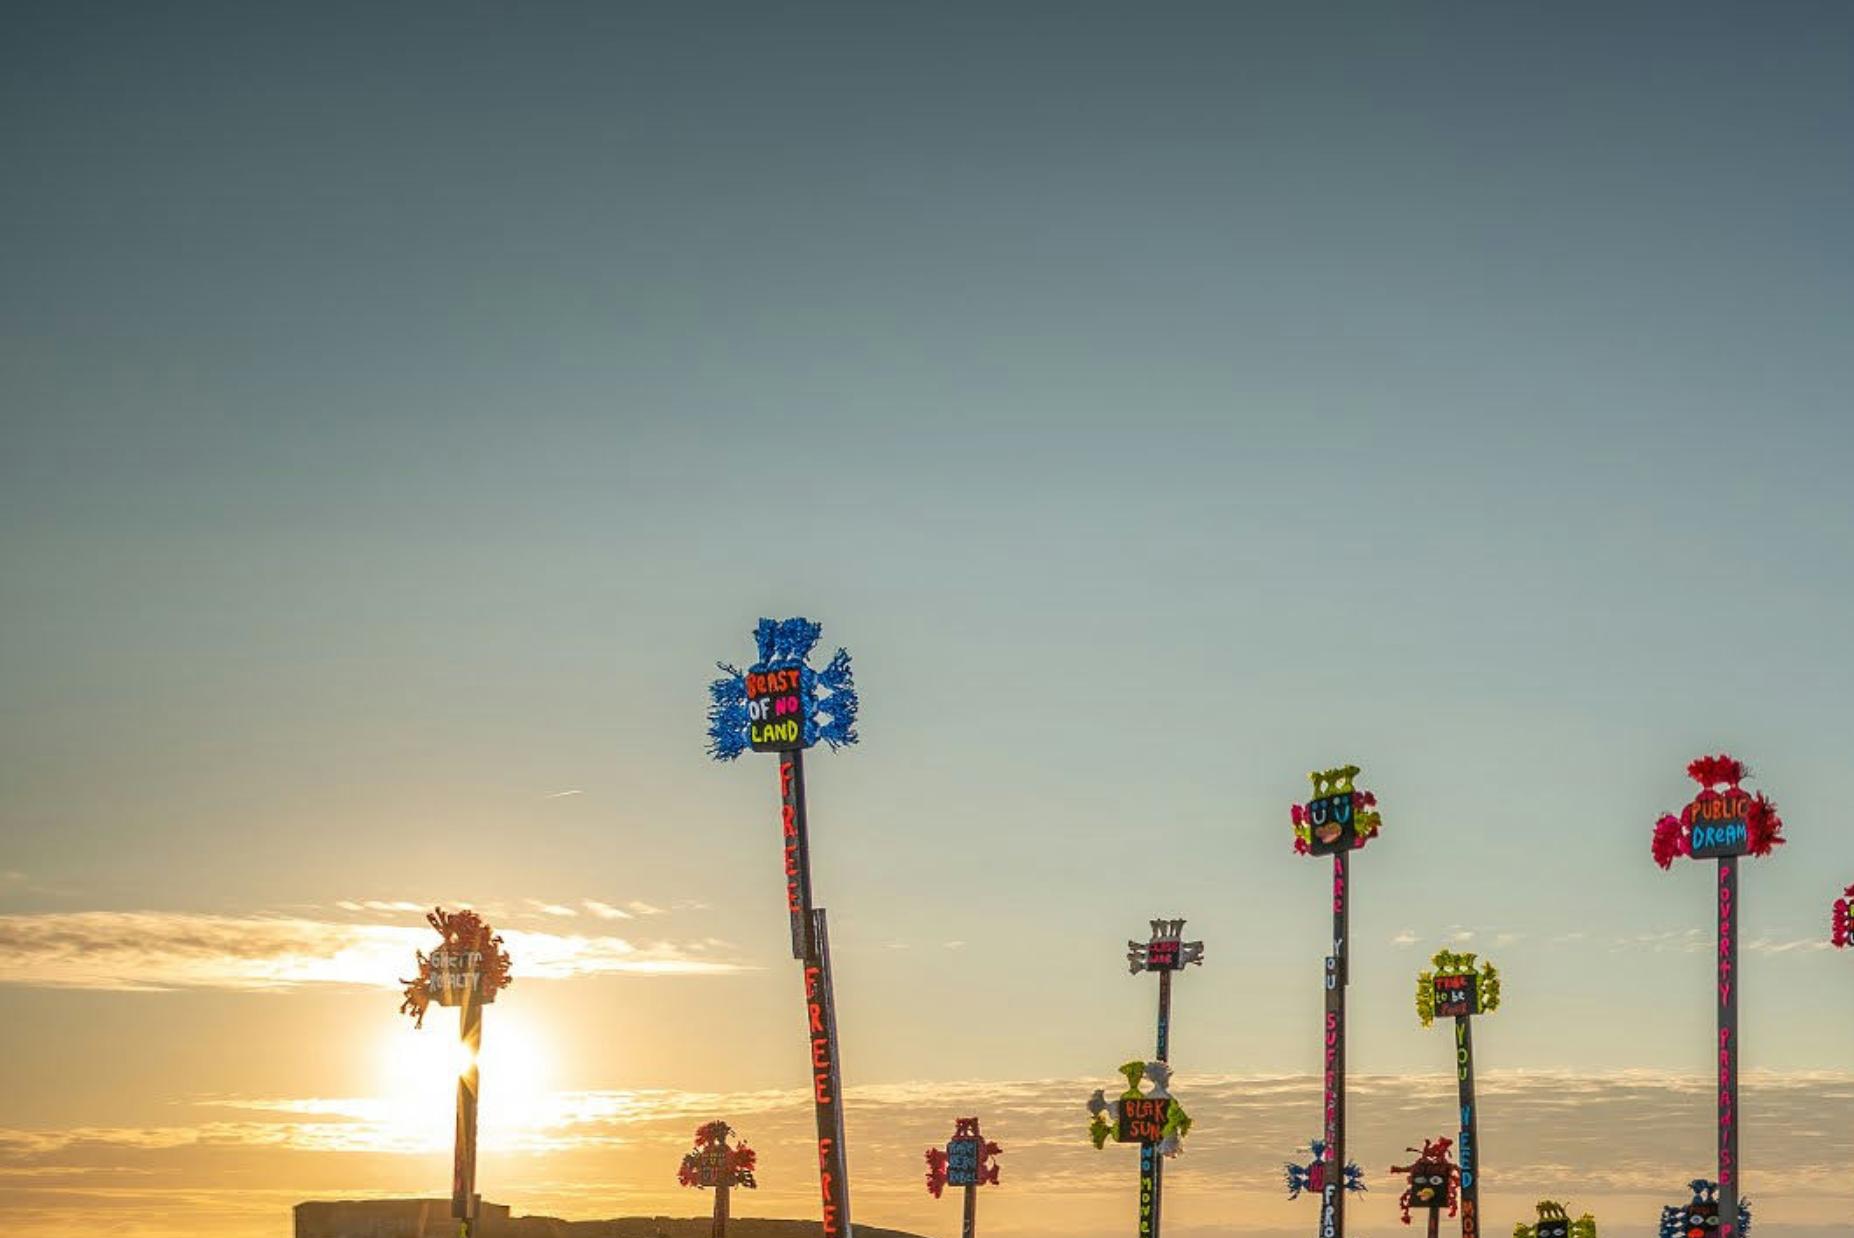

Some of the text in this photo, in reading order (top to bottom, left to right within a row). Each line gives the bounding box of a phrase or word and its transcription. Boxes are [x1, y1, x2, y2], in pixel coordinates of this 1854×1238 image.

[749, 695, 799, 720] OF NO
[751, 720, 799, 742] LAND
[1691, 799, 1749, 823] PUBLIC
[780, 762, 800, 912] FREE
[805, 967, 831, 1104] FREE
[1456, 1022, 1468, 1081] YOU
[1131, 1120, 1160, 1141] SUN
